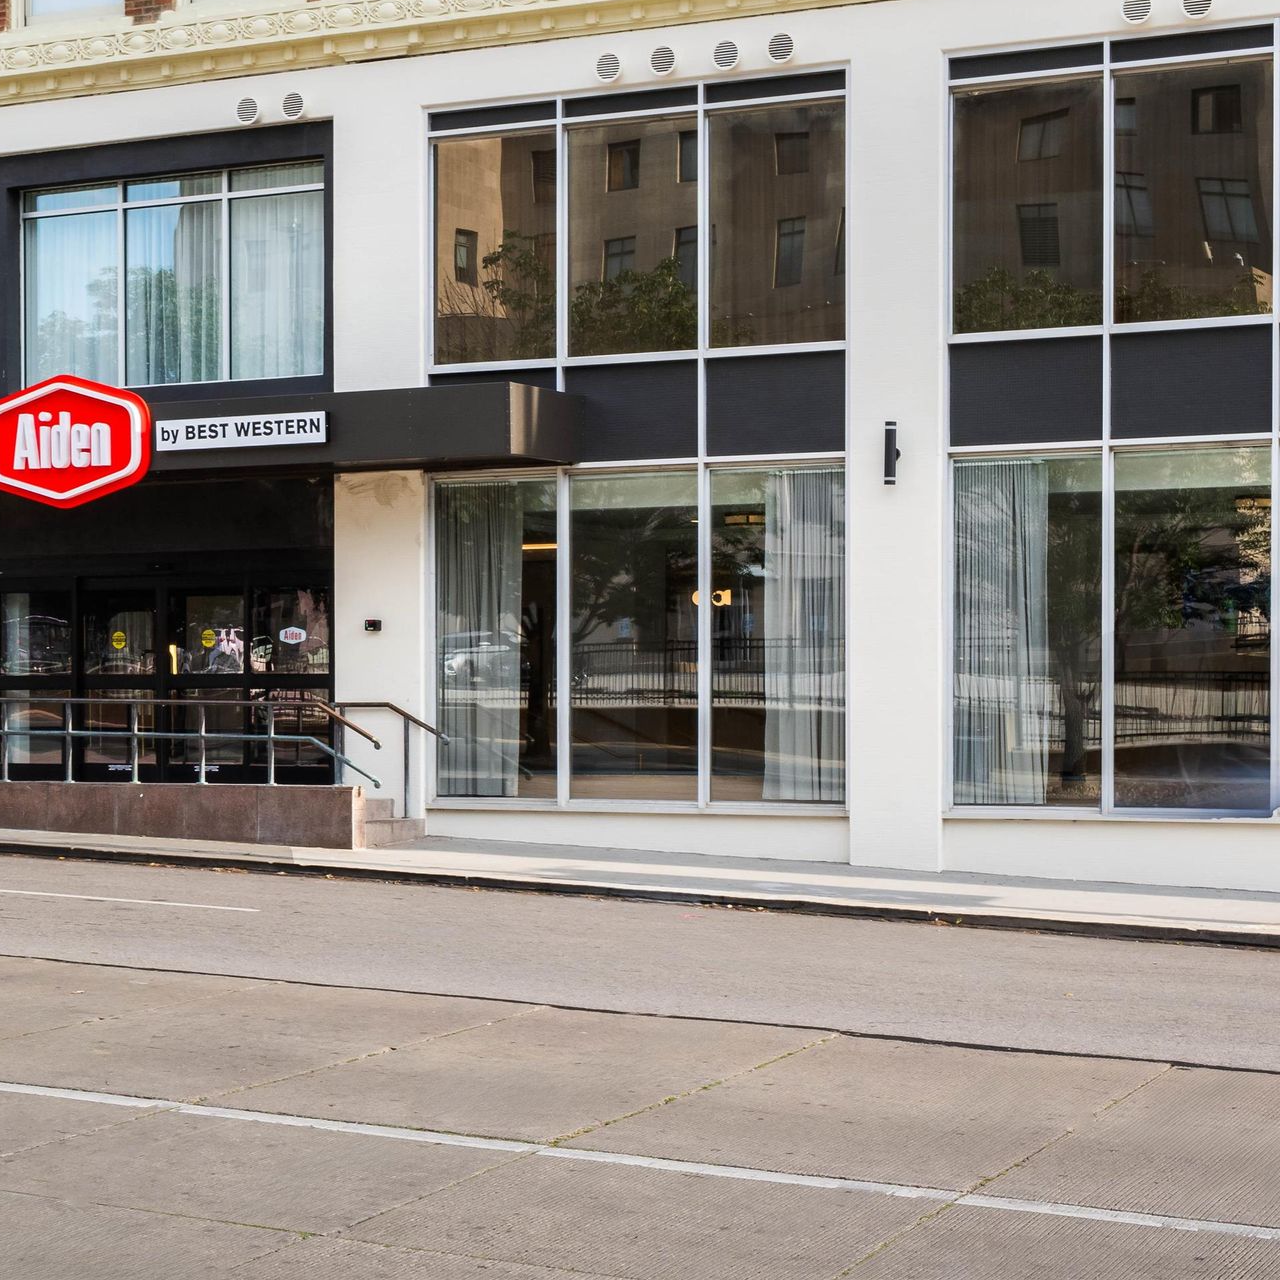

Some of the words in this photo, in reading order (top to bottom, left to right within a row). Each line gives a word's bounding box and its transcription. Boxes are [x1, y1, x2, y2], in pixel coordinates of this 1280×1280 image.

[13, 410, 112, 471] Aiden
[160, 424, 180, 445] by
[185, 422, 229, 440] BEST
[234, 417, 322, 438] WESTERN
